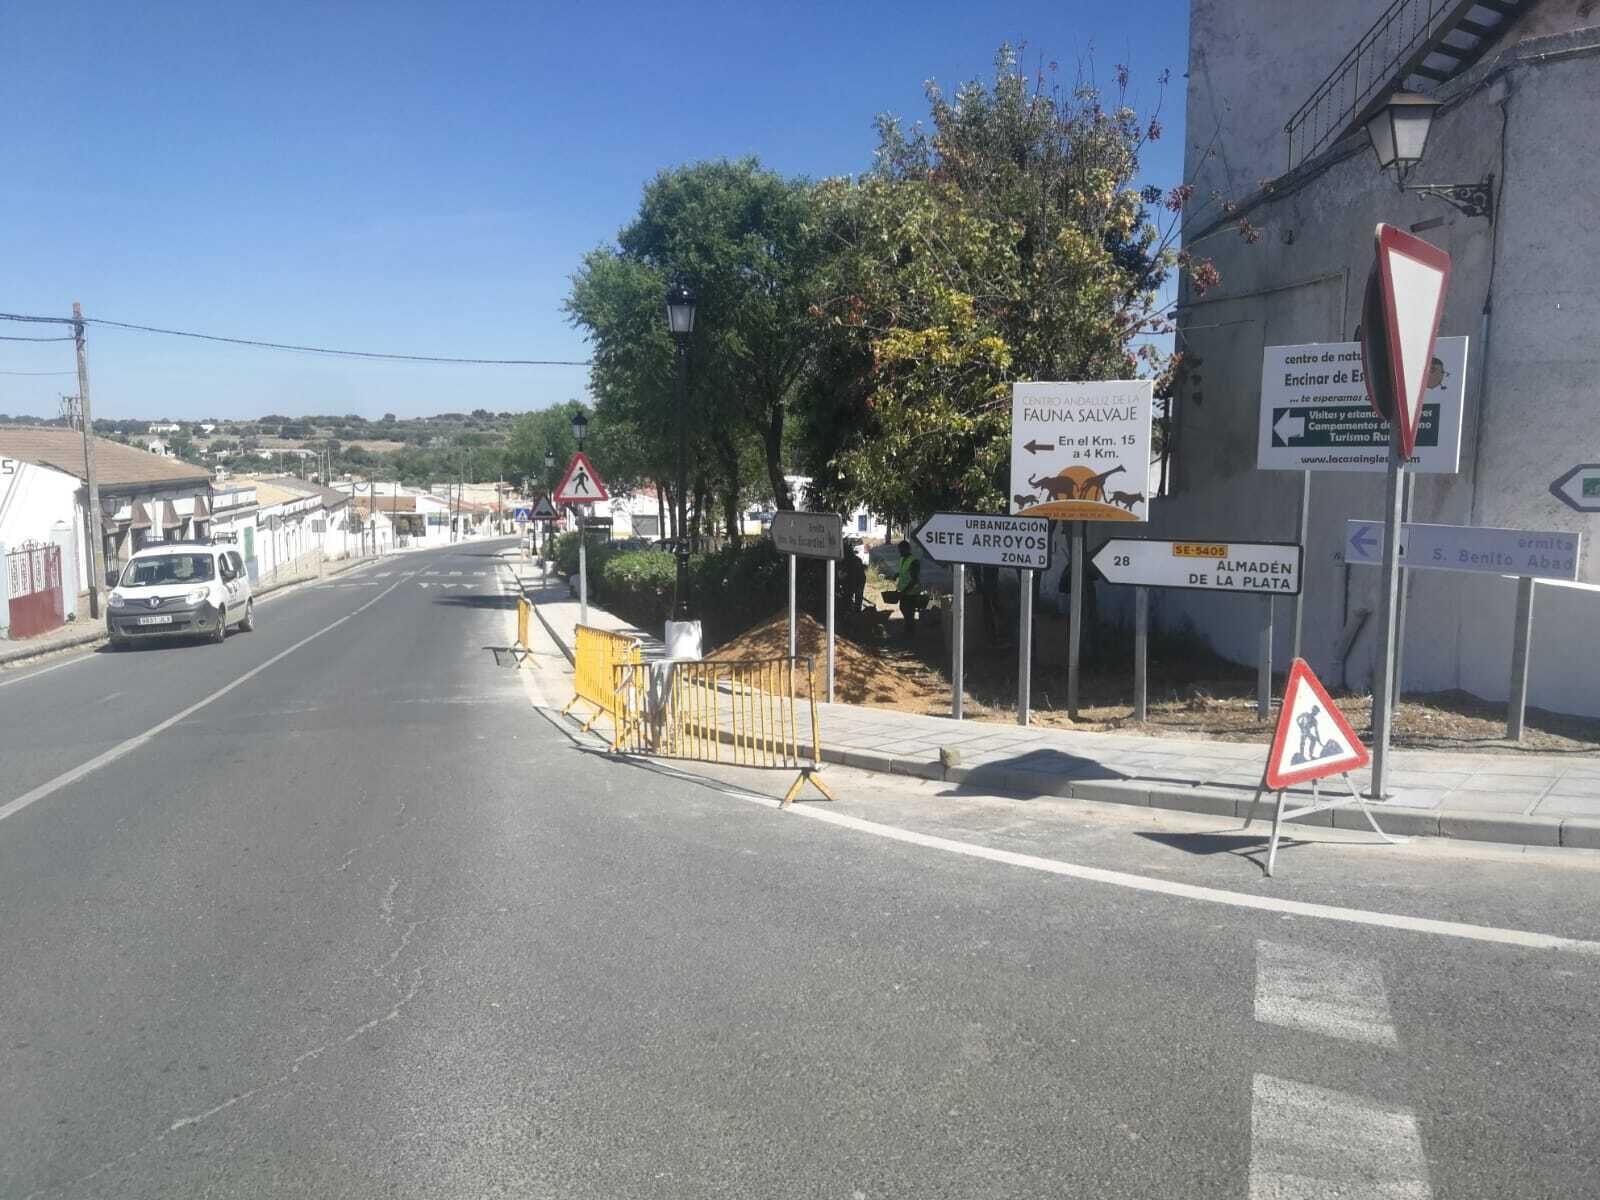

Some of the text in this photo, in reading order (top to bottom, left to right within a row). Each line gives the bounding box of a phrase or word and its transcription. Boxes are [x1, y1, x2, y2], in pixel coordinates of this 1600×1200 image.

[1284, 354, 1318, 364] centro
[1321, 352, 1335, 362] de
[1284, 372, 1330, 386] Encinar
[1333, 370, 1348, 383] de
[1022, 396, 1061, 406] CENTRO
[1112, 395, 1125, 404] DE
[1127, 394, 1140, 403] LA
[1301, 394, 1311, 402] te
[1313, 393, 1362, 404] esperamos
[1024, 406, 1138, 423] FAUNA SALVAJE
[1309, 410, 1337, 419] Visitas
[1340, 411, 1346, 420] y
[1308, 421, 1378, 431] Campamentos
[1058, 435, 1136, 446] En el Km. 15
[1330, 432, 1370, 442] Turismo
[1073, 449, 1119, 459] a 4 Km.
[965, 519, 1047, 533] URBANIZACIÓN
[925, 531, 1046, 550] SIETE ARROYOS
[1517, 537, 1573, 551] ermita
[1175, 546, 1225, 556] SE-5405
[1001, 552, 1046, 565] ZONA D
[1113, 556, 1130, 567] 28
[1432, 548, 1573, 570] S. Benito Abad
[1216, 560, 1292, 574] ALMADÉN
[1189, 573, 1290, 590] DE LA PLATA
